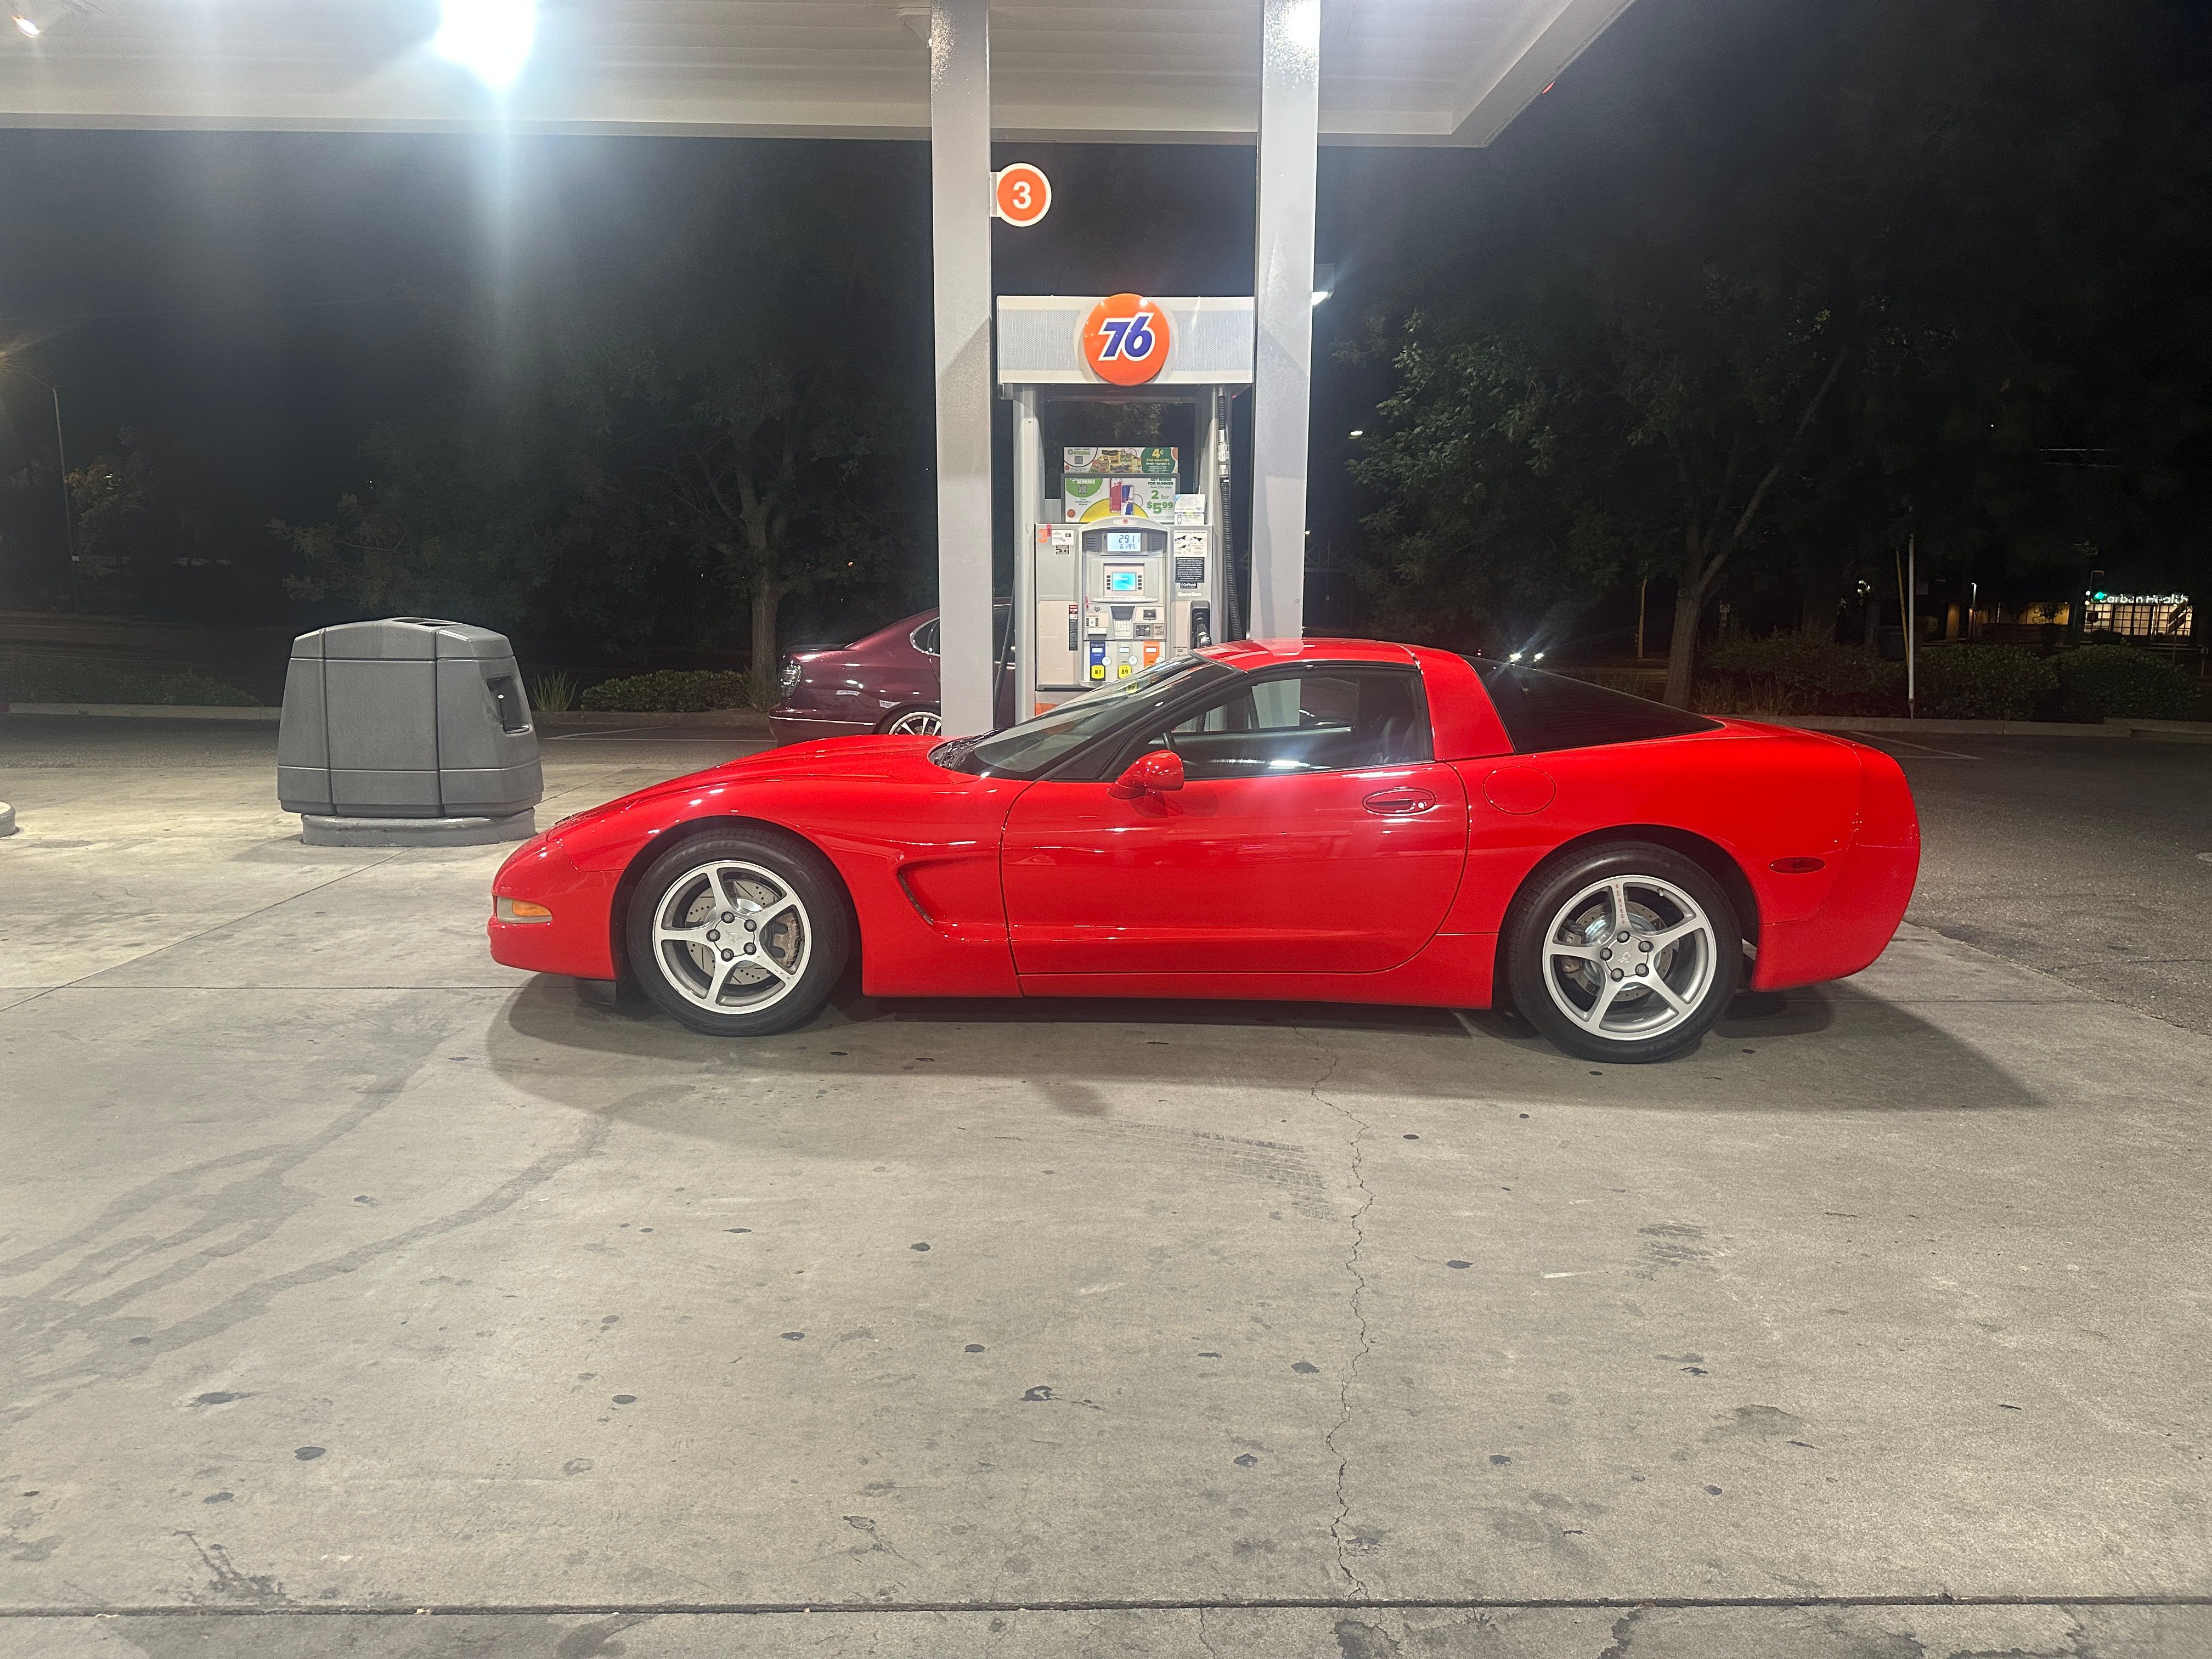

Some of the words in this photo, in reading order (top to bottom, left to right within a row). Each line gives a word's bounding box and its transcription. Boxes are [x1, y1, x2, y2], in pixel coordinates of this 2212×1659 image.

[1013, 181, 1031, 209] 3
[1098, 312, 1155, 362] 76
[1151, 489, 1159, 500] 2
[1038, 529, 1047, 543] 3
